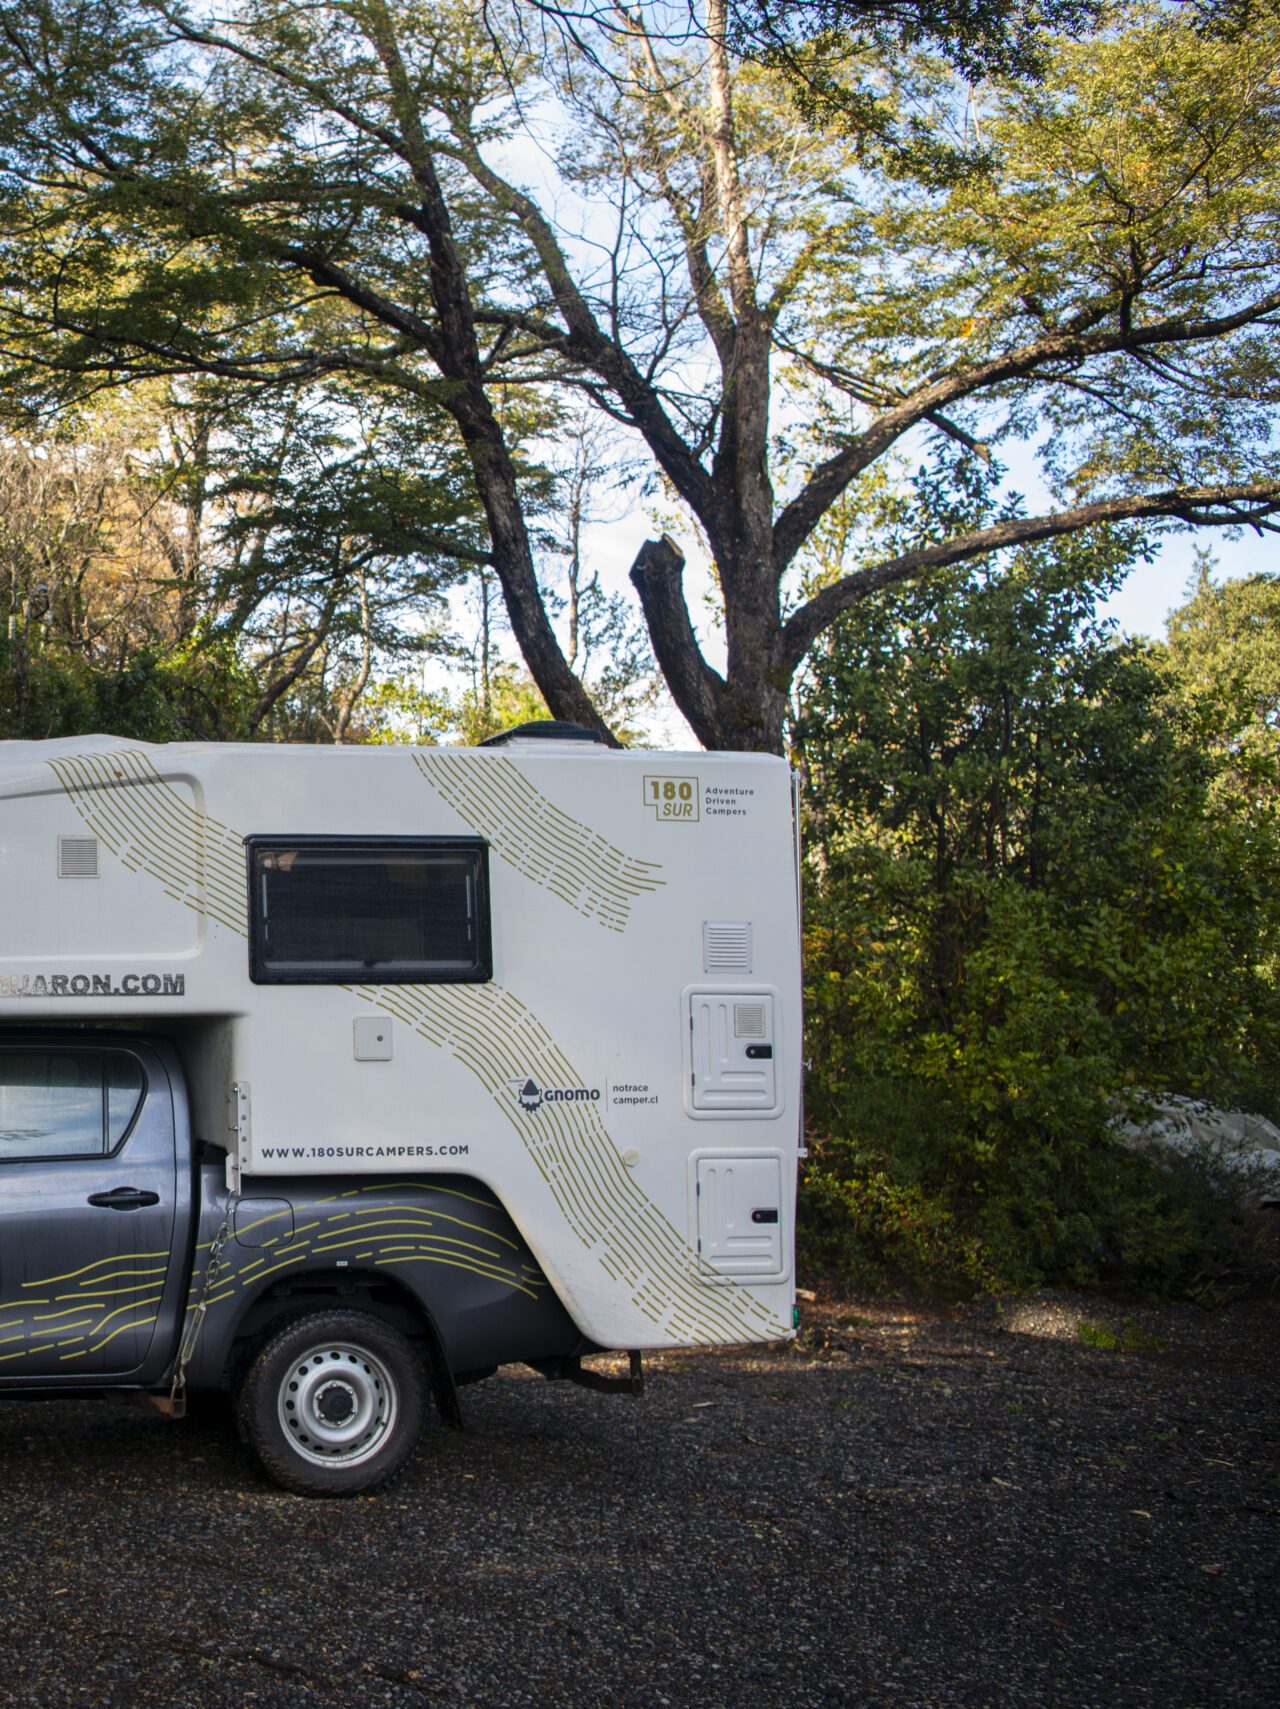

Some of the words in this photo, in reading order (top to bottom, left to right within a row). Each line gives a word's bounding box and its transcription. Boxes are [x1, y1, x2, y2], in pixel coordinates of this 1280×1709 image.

[650, 781, 692, 801] 180
[705, 786, 754, 796] Adventure
[705, 797, 736, 805] Driven
[662, 802, 693, 817] SUR
[705, 806, 747, 817] Campers
[612, 1084, 649, 1093] notrace
[612, 1095, 658, 1106] camper.cl
[261, 1144, 469, 1159] WWW.180SURCAMPERS.COM
